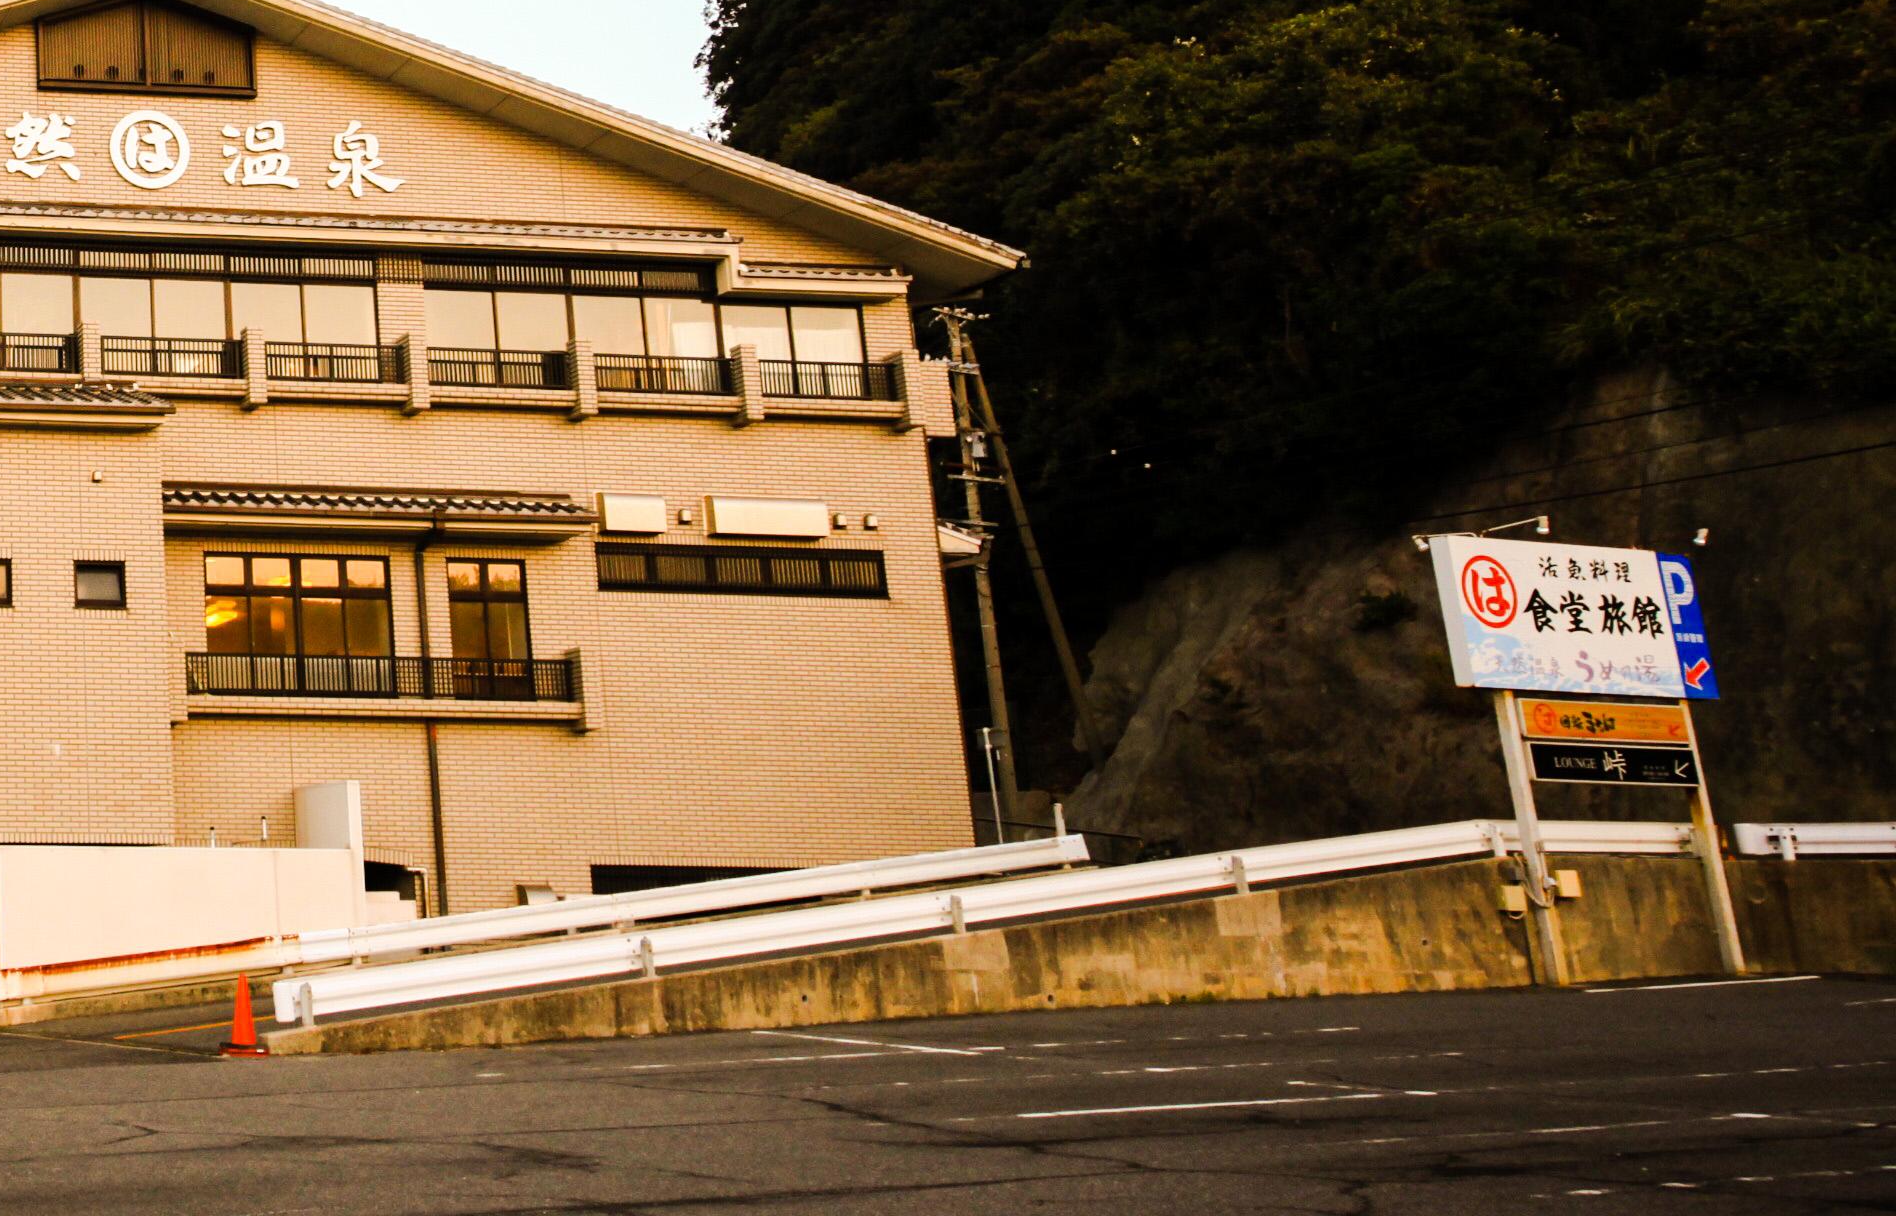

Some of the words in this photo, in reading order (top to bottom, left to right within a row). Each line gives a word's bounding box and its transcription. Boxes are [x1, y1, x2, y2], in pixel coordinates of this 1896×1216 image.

[221, 120, 406, 197] 温泉
[1538, 556, 1632, 583] 活魚料理
[1660, 560, 1694, 625] P
[1524, 588, 1664, 639] 食堂旅館
[1554, 756, 1597, 770] LOUNGE
[1603, 749, 1628, 781] 峠
